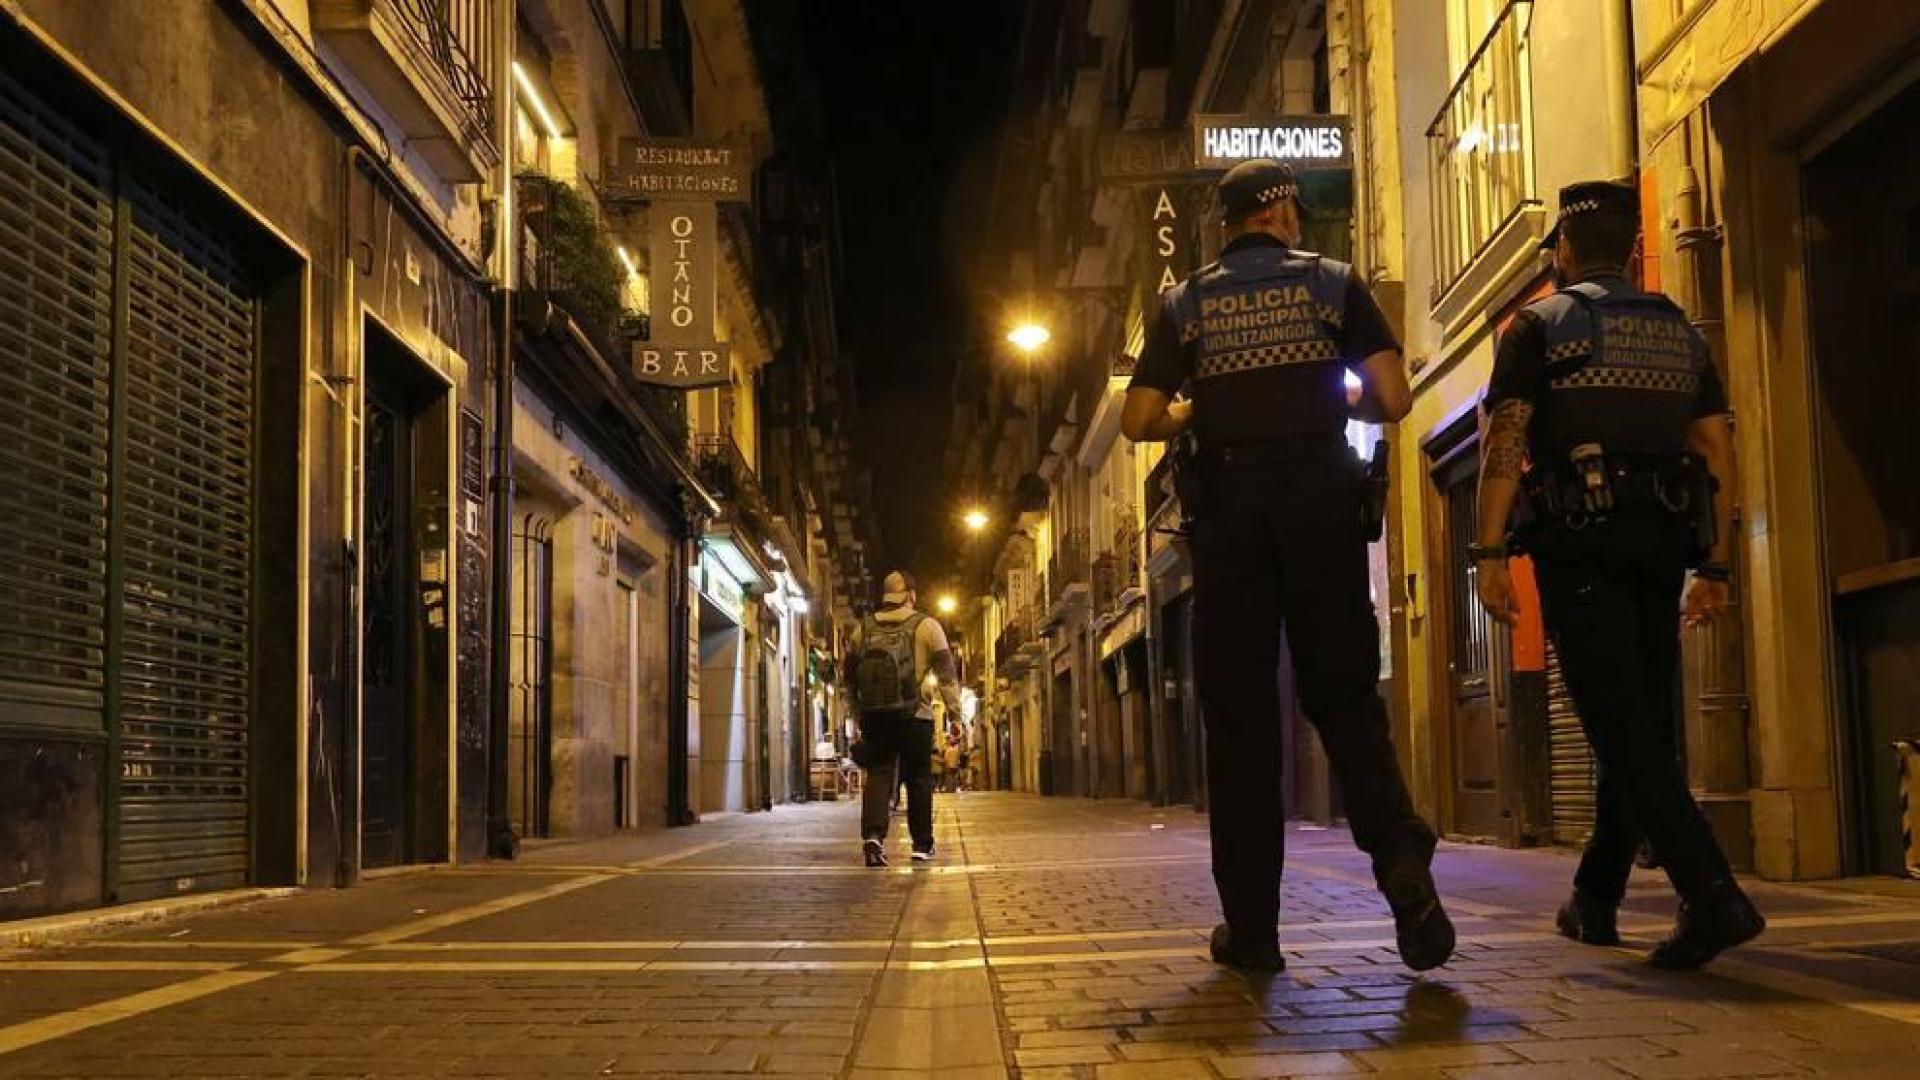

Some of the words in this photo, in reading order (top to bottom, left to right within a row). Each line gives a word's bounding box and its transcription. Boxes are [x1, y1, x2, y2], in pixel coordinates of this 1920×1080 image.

[1203, 127, 1343, 158] HABITACIONES
[628, 175, 738, 193] HABITACIONES
[670, 216, 694, 327] OTANO
[1202, 285, 1312, 316] POLICIA
[1203, 304, 1315, 332] MUNICIPAL
[1602, 316, 1689, 338] POLICIA
[641, 350, 719, 377] BAR
